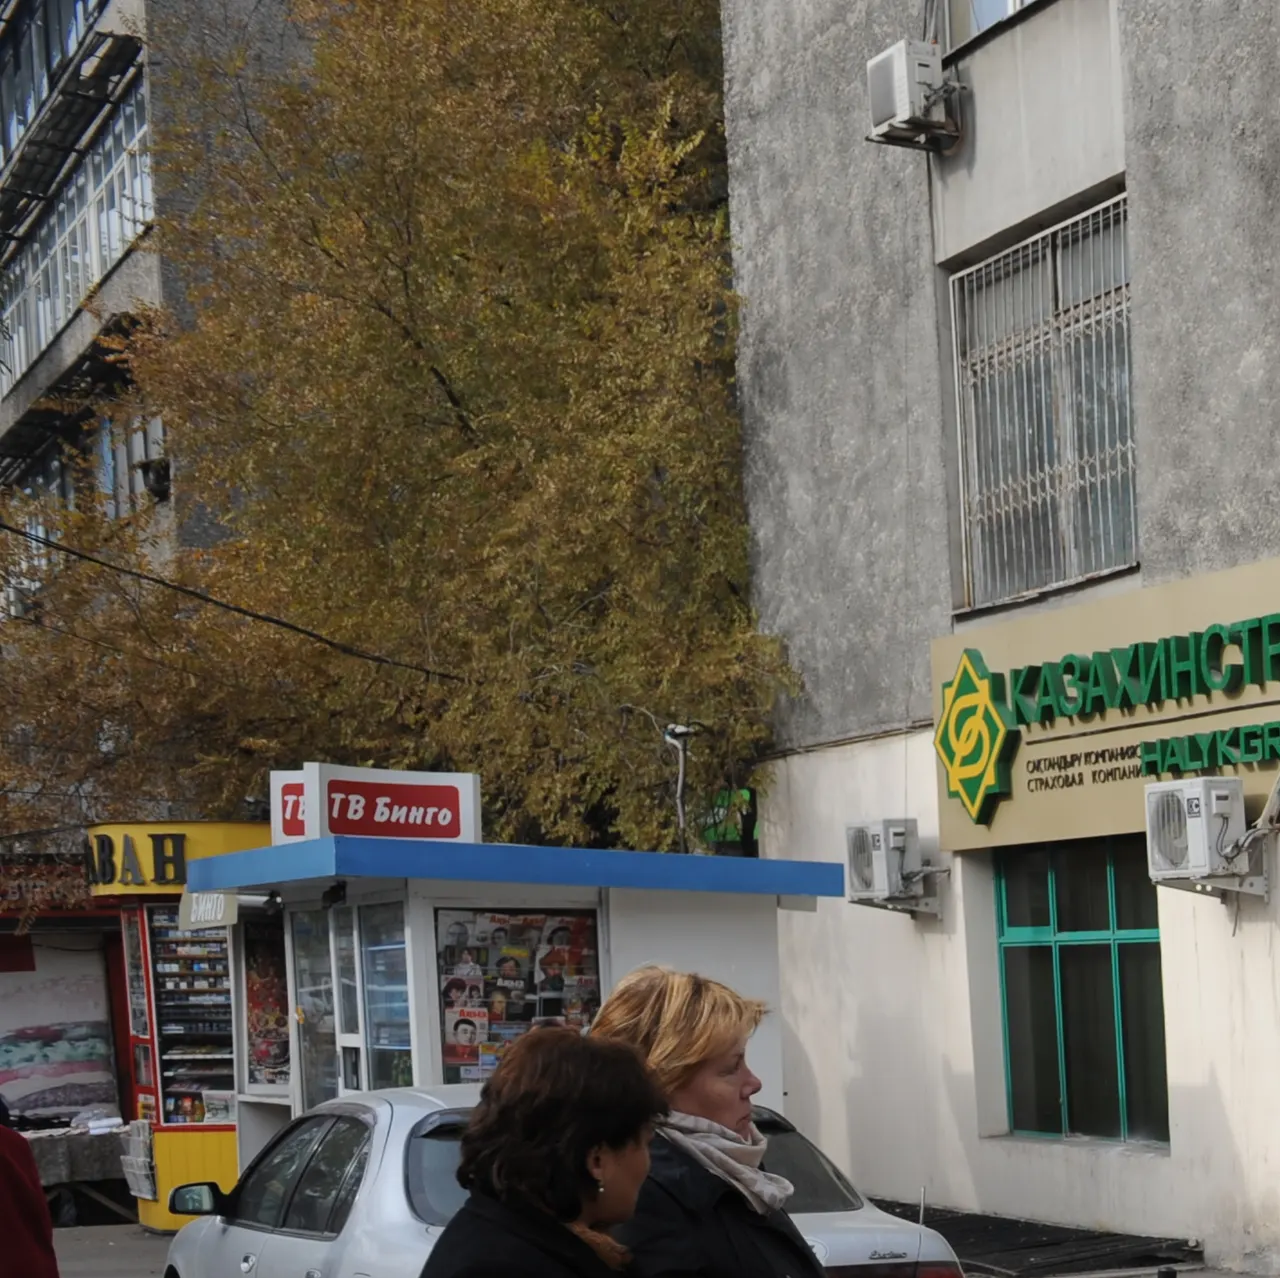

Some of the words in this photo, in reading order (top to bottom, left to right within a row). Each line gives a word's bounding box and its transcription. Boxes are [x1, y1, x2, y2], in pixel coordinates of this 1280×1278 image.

[1027, 772, 1084, 793] СТРАХОВАЯ
[331, 793, 366, 820] ТВ
[373, 797, 453, 826] Бинго
